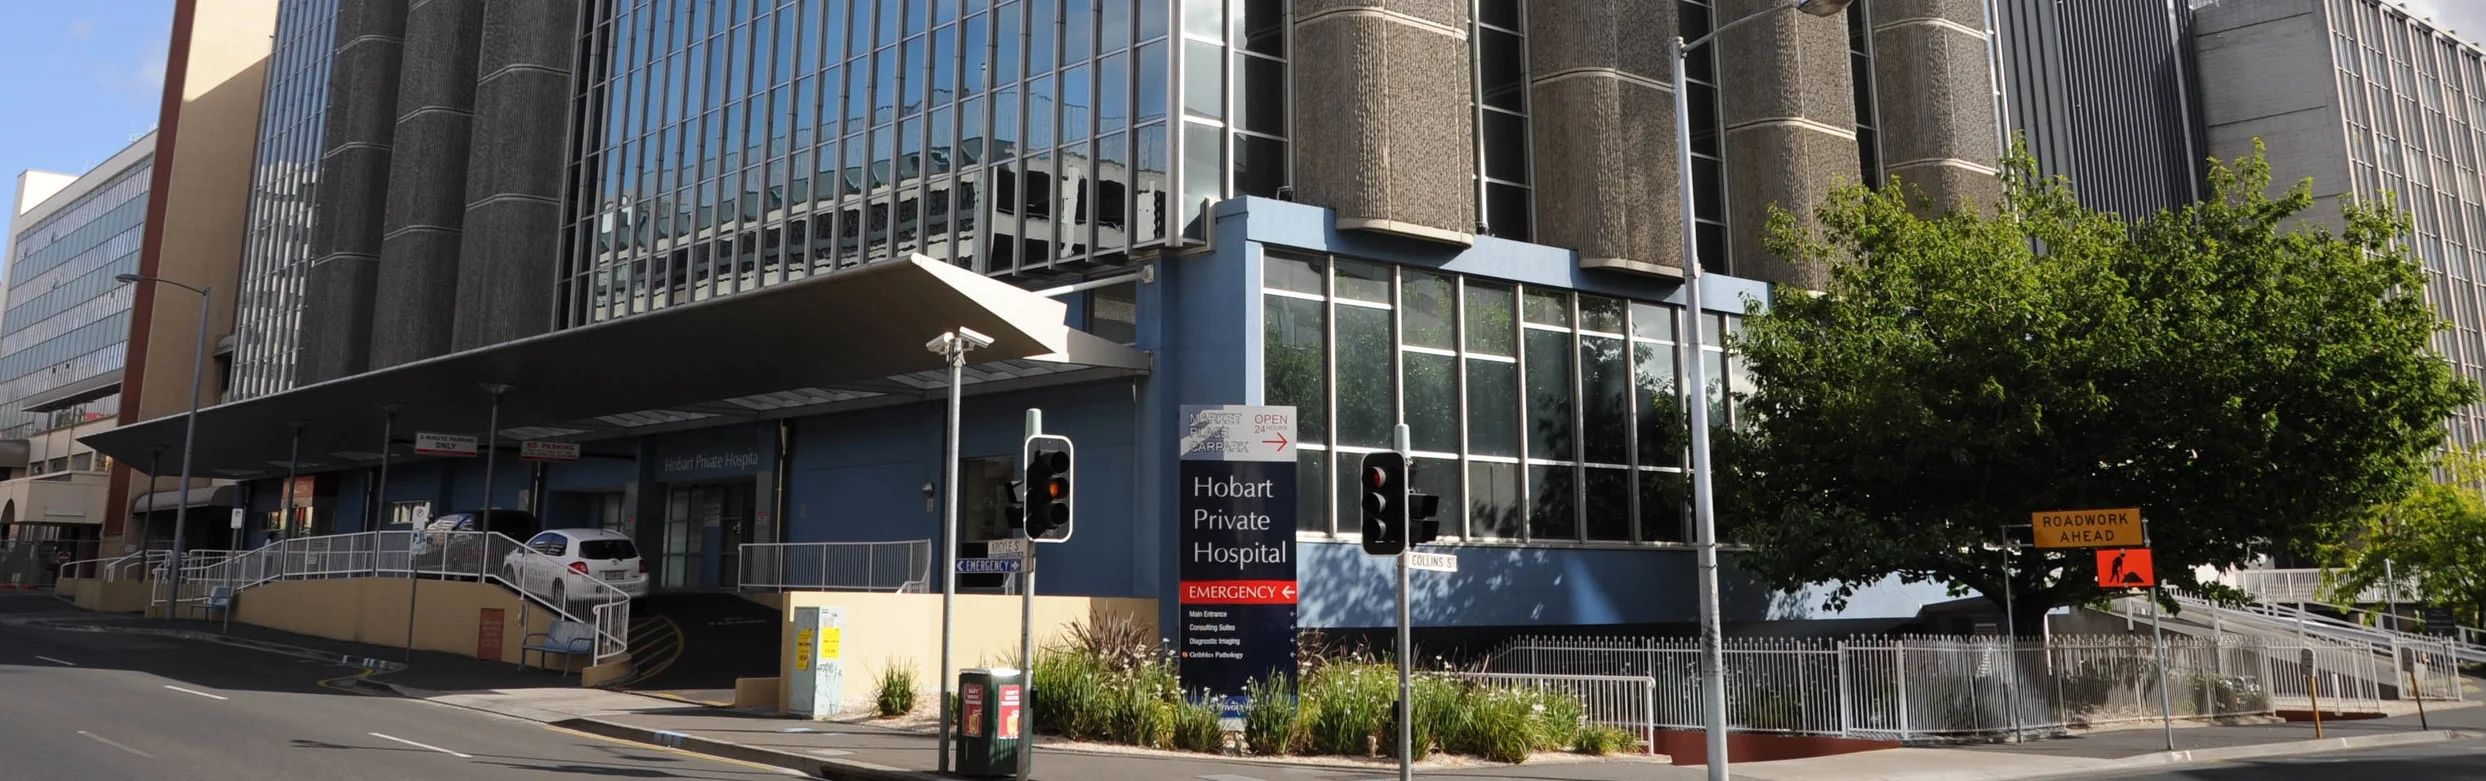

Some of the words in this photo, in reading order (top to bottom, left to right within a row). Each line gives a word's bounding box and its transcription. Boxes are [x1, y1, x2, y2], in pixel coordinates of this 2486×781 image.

[1189, 412, 1242, 426] MARKET
[1254, 414, 1288, 424] OPEN
[1189, 426, 1230, 438] PLACE
[1254, 425, 1266, 434] 24
[425, 434, 448, 442] MINUTE
[449, 435, 475, 444] PARKING
[435, 441, 457, 450] ONLY
[526, 441, 538, 449] NO
[541, 442, 575, 451] PARKING
[1189, 441, 1250, 453] CARPARK
[665, 457, 693, 472] Hobart
[695, 453, 723, 470] Private
[725, 452, 759, 471] Hospita
[1194, 474, 1274, 498] Hobart
[1194, 508, 1271, 530] Private
[2042, 513, 2129, 527] ROADWORK
[2060, 529, 2115, 543] AHEAD
[1194, 540, 1286, 570] Hospital
[1412, 555, 1444, 567] COLLINS
[966, 560, 1010, 572] EMERGENCY
[1188, 585, 1277, 599] EMERGENCY
[1189, 610, 1203, 618] Main
[1203, 610, 1228, 618] Entrance
[1189, 623, 1218, 632] Consulting
[1218, 623, 1236, 632] Suites
[1189, 637, 1218, 645] Diagnostic
[1218, 637, 1240, 646] Imaging
[1215, 651, 1244, 660] Pathology
